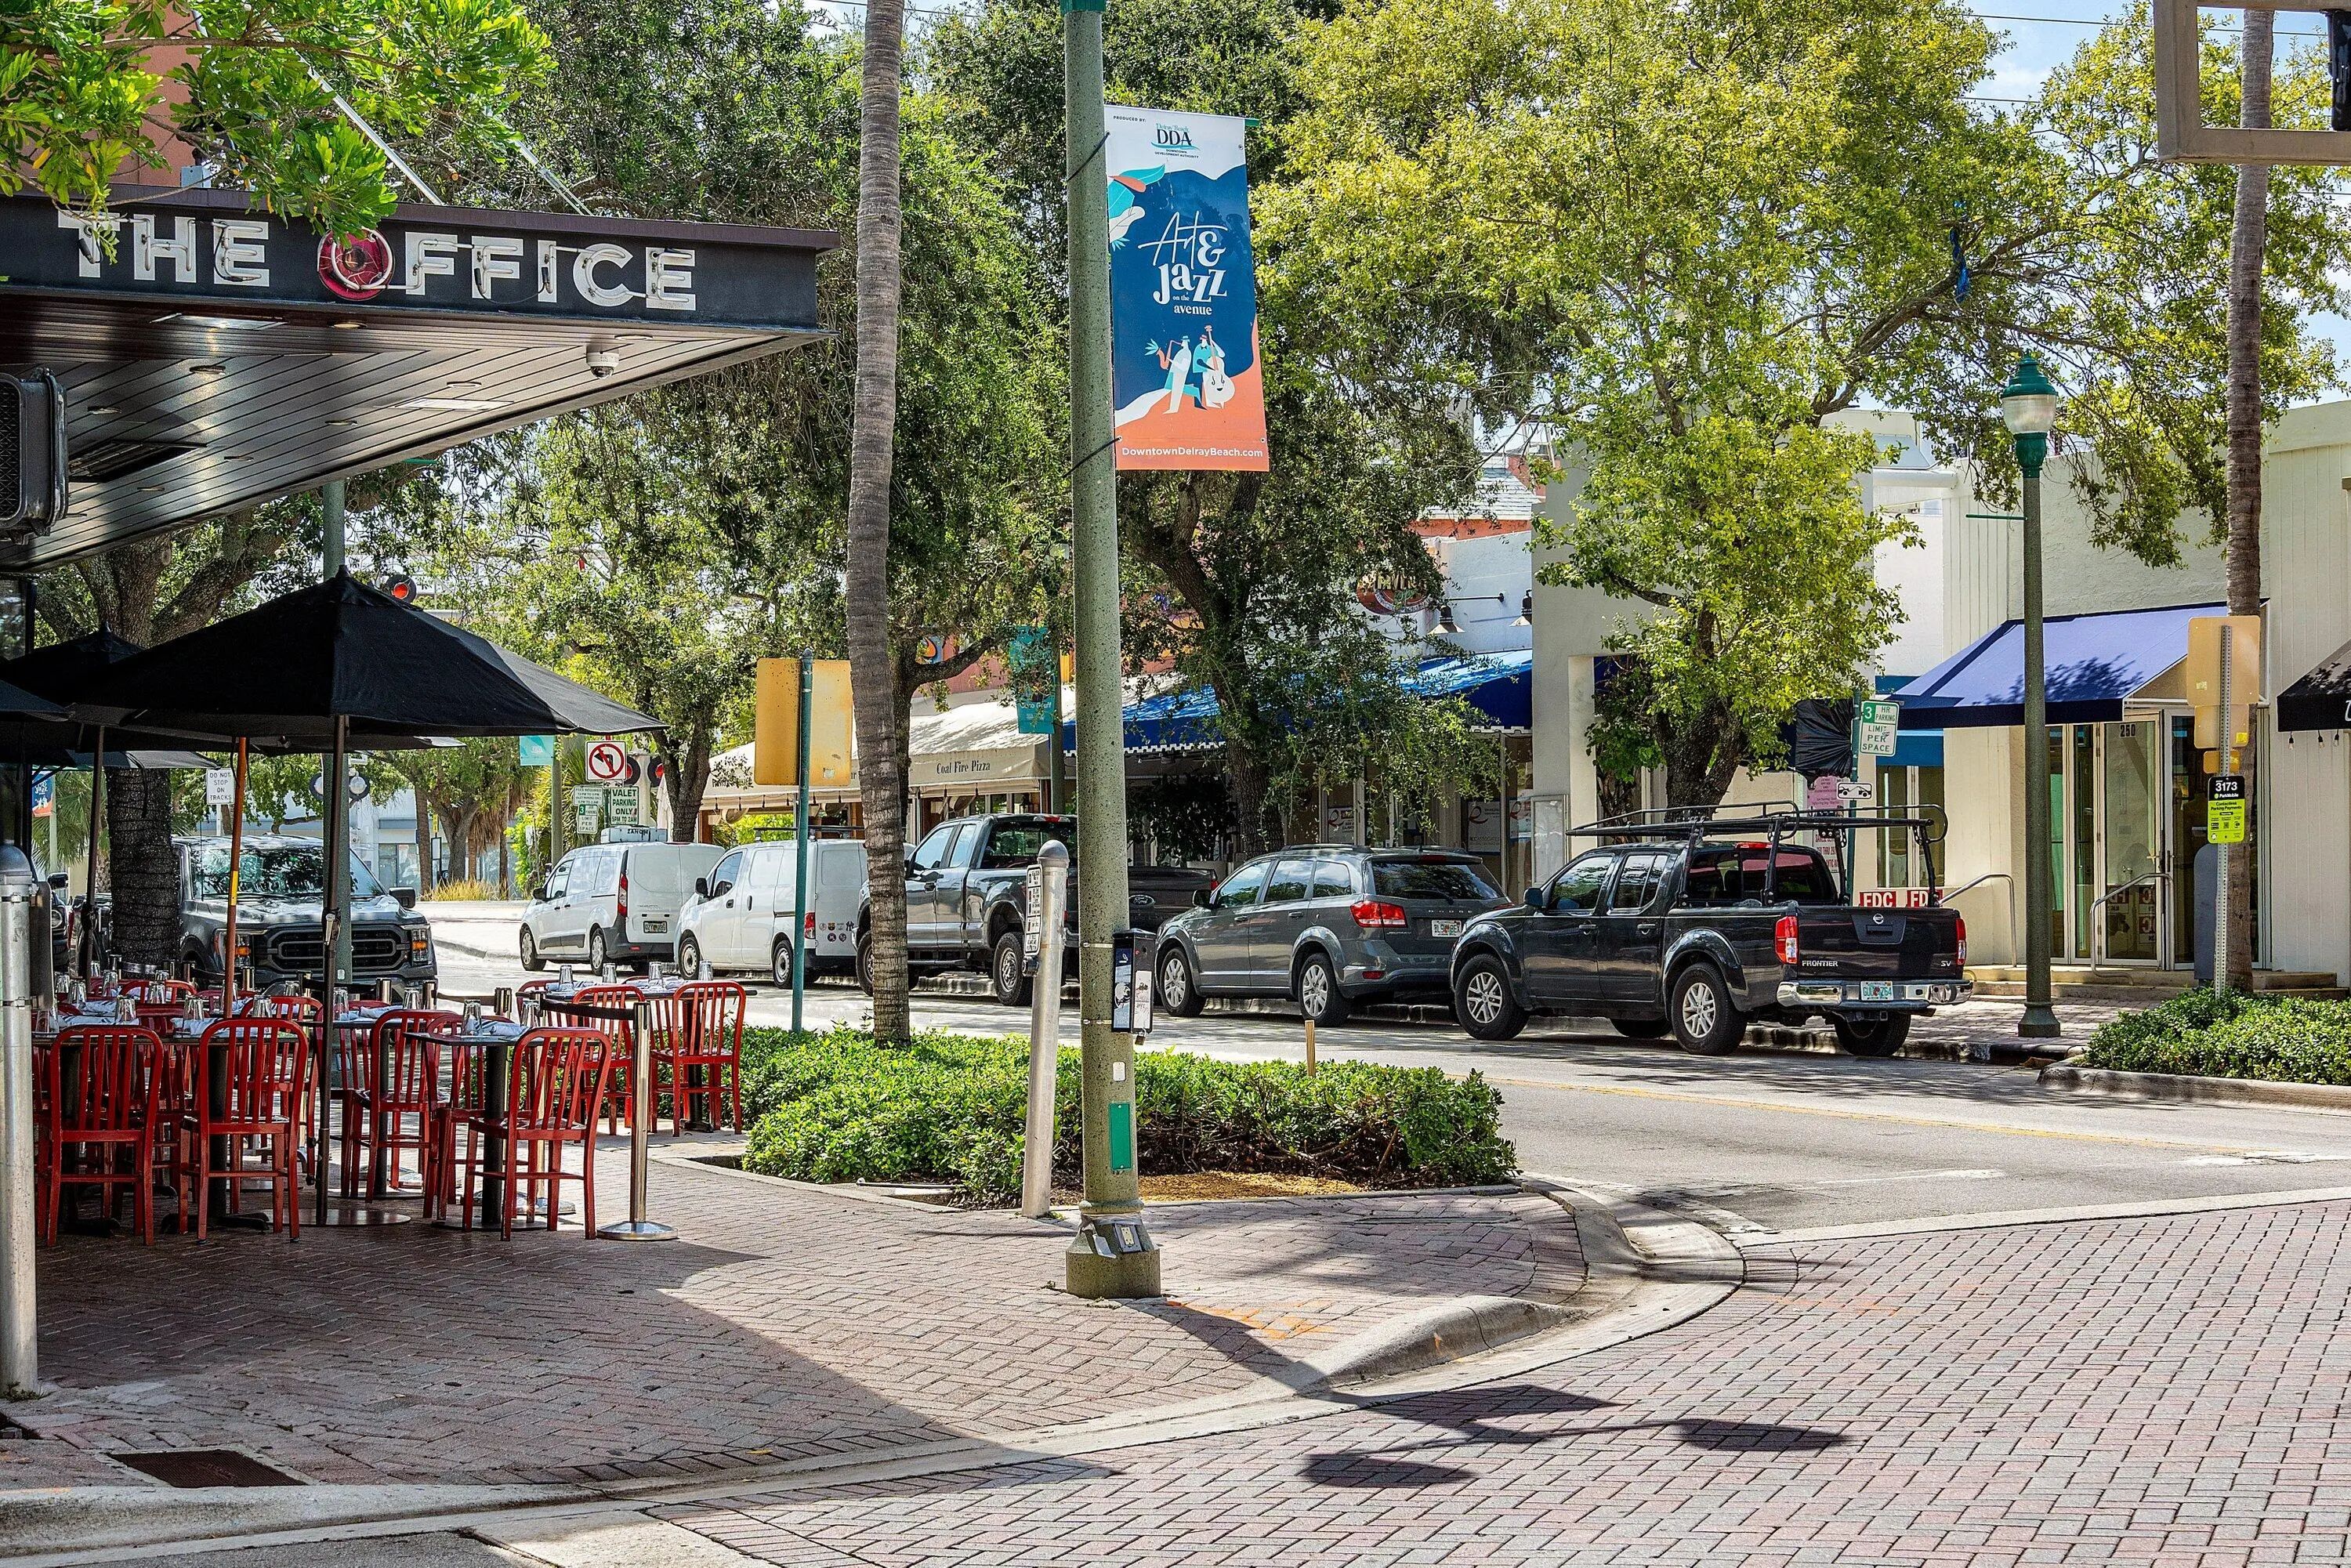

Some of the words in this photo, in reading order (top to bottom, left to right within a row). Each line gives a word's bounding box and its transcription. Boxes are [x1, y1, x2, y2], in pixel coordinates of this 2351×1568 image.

[1157, 129, 1193, 147] DDA
[1138, 211, 1228, 270] Art
[1197, 230, 1226, 267] &
[58, 210, 270, 288] THE
[317, 226, 697, 311] OFFICE
[1174, 303, 1212, 316] avenue
[1121, 446, 1263, 458] DowntownDelrayBeach.com
[1864, 706, 1872, 719] 3
[1875, 713, 1896, 722] PARKING
[2120, 723, 2135, 737] 250
[1867, 734, 1886, 743] PER
[1862, 743, 1890, 752] SPACE
[936, 762, 952, 774] Coal
[954, 761, 969, 773] Fire
[971, 759, 991, 772] Pizza
[2215, 781, 2237, 791] 3173
[579, 806, 585, 814] 3
[1863, 892, 1893, 907] FDC
